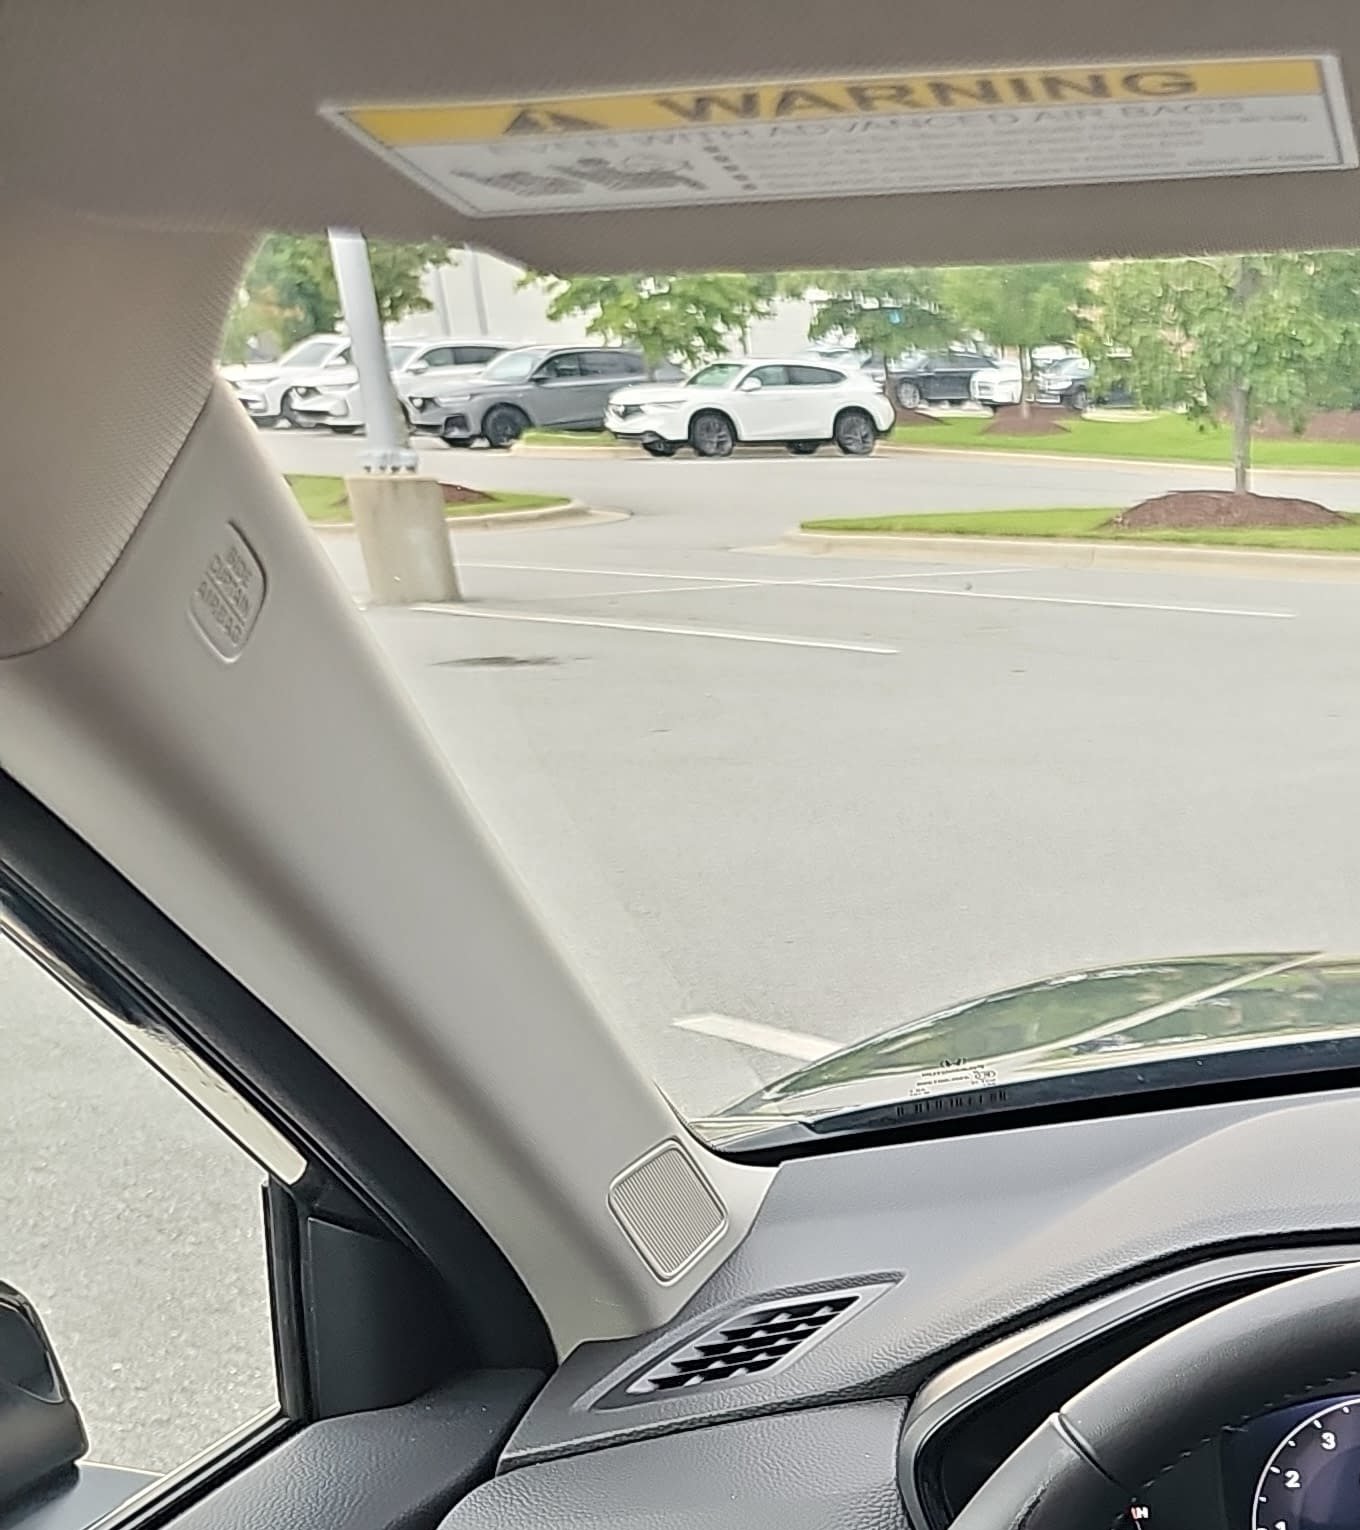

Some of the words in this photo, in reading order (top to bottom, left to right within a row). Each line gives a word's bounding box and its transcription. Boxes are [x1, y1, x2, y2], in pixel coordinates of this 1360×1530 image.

[652, 69, 1199, 124] WARNING
[1320, 1432, 1336, 1451] 3
[1285, 1470, 1301, 1488] 2
